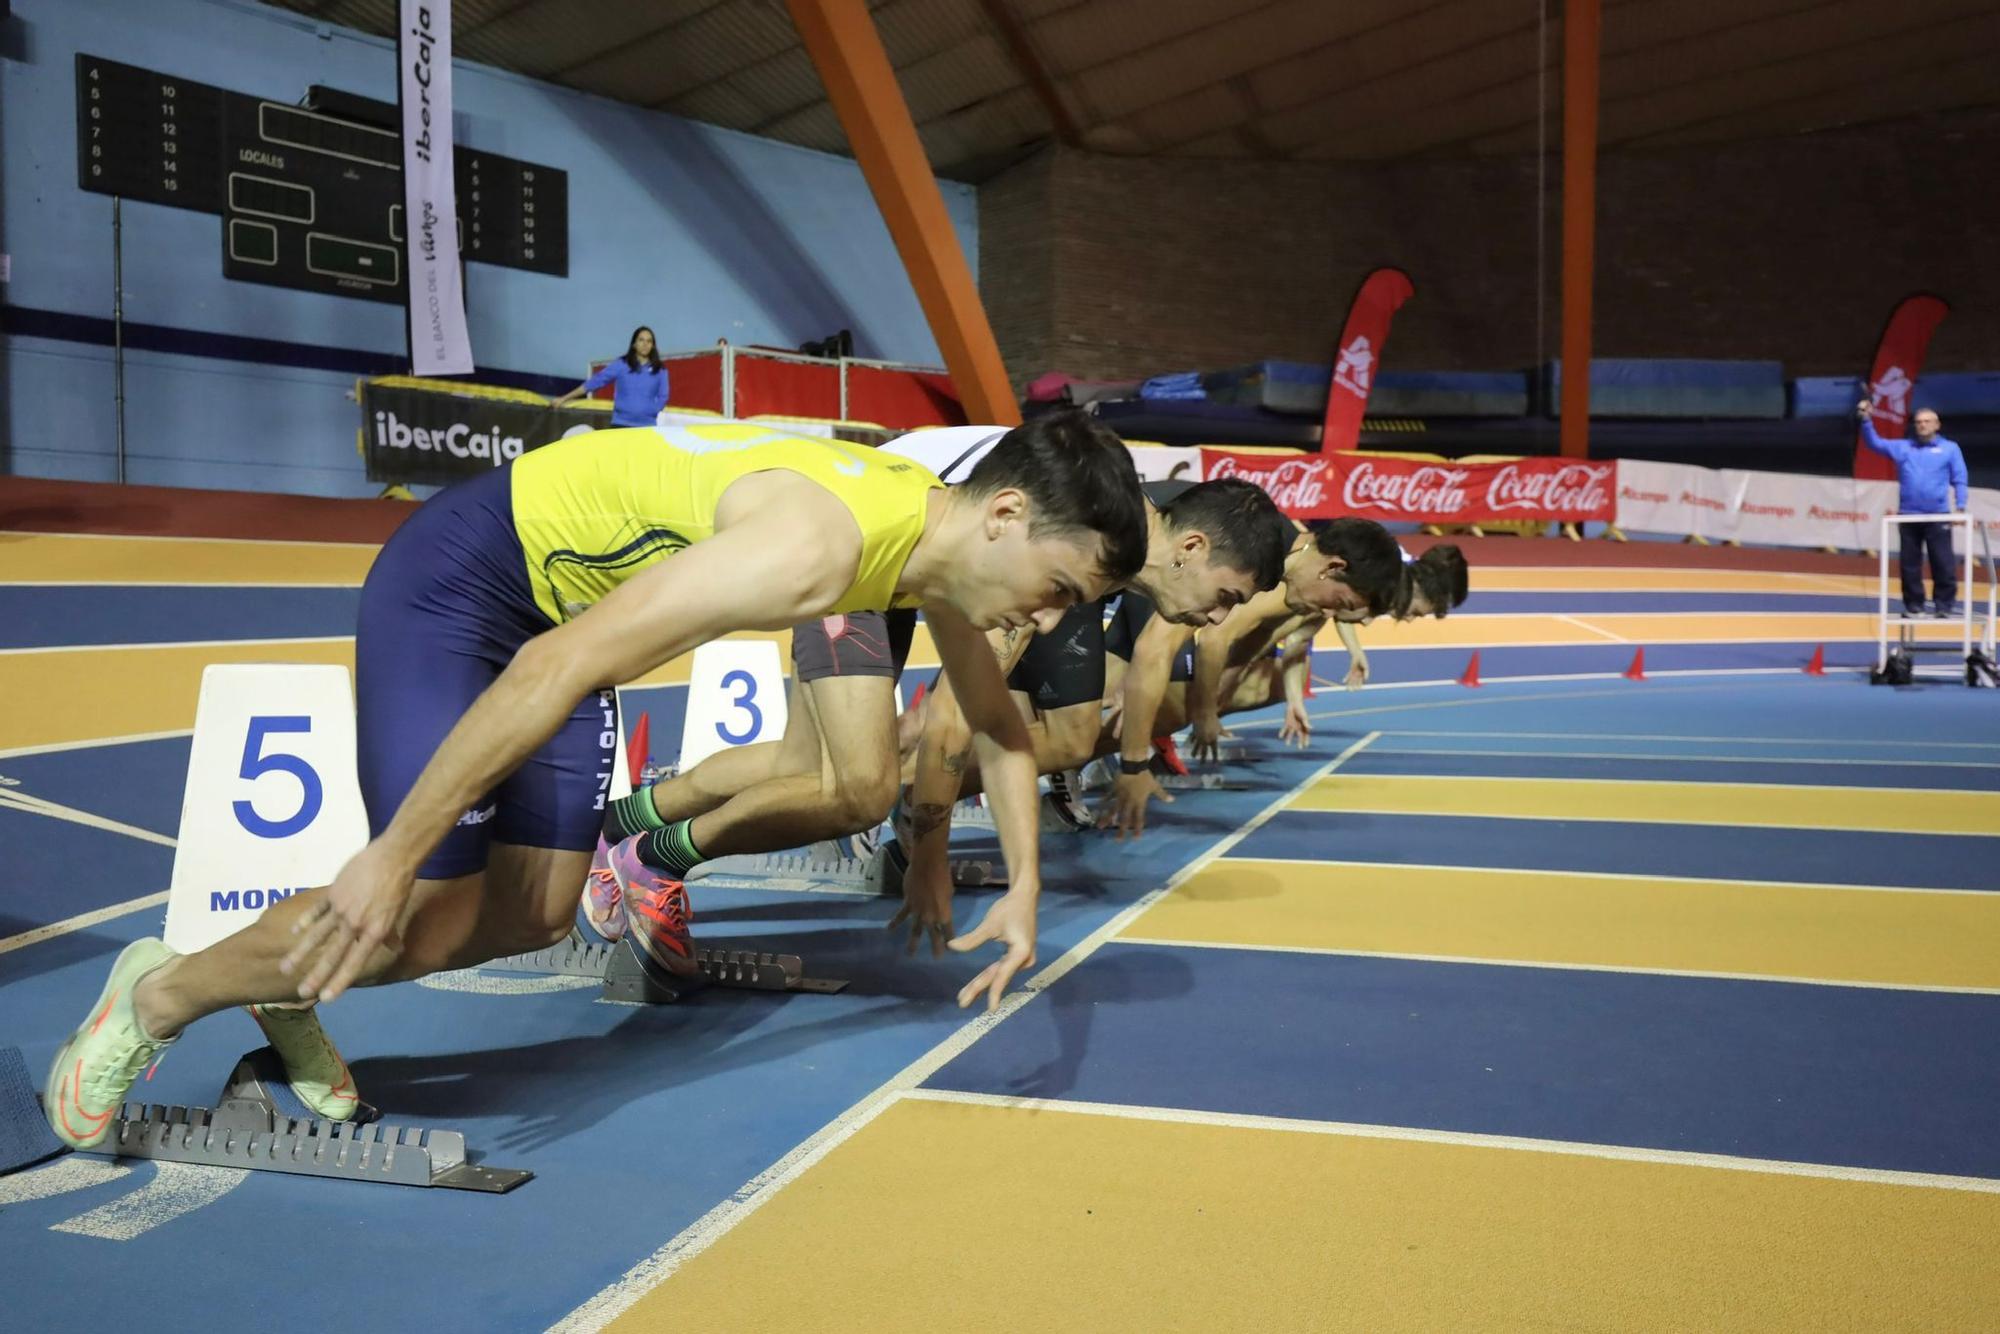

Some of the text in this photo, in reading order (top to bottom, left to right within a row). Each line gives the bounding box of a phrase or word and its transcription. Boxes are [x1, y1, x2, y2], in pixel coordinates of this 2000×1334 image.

[90, 68, 99, 80] 4
[412, 6, 436, 163] iberCaja
[91, 87, 100, 99] 5
[162, 85, 176, 98] 10
[91, 107, 100, 119] 6
[162, 104, 174, 116] 11
[92, 126, 100, 138] 7
[163, 123, 177, 136] 12
[92, 145, 101, 157] 8
[164, 141, 177, 154] 13
[240, 149, 285, 169] LOCALES
[92, 164, 101, 176] 9
[164, 160, 177, 172] 14
[164, 179, 178, 191] 15
[428, 296, 445, 343] BANCO
[436, 345, 446, 361] EL
[375, 411, 524, 467] iberCaja
[1344, 462, 1470, 513] Coca-Cola
[1486, 465, 1612, 511] Coca-Cola
[715, 669, 763, 746] 3
[232, 715, 323, 839] 5
[210, 887, 312, 912] MON
